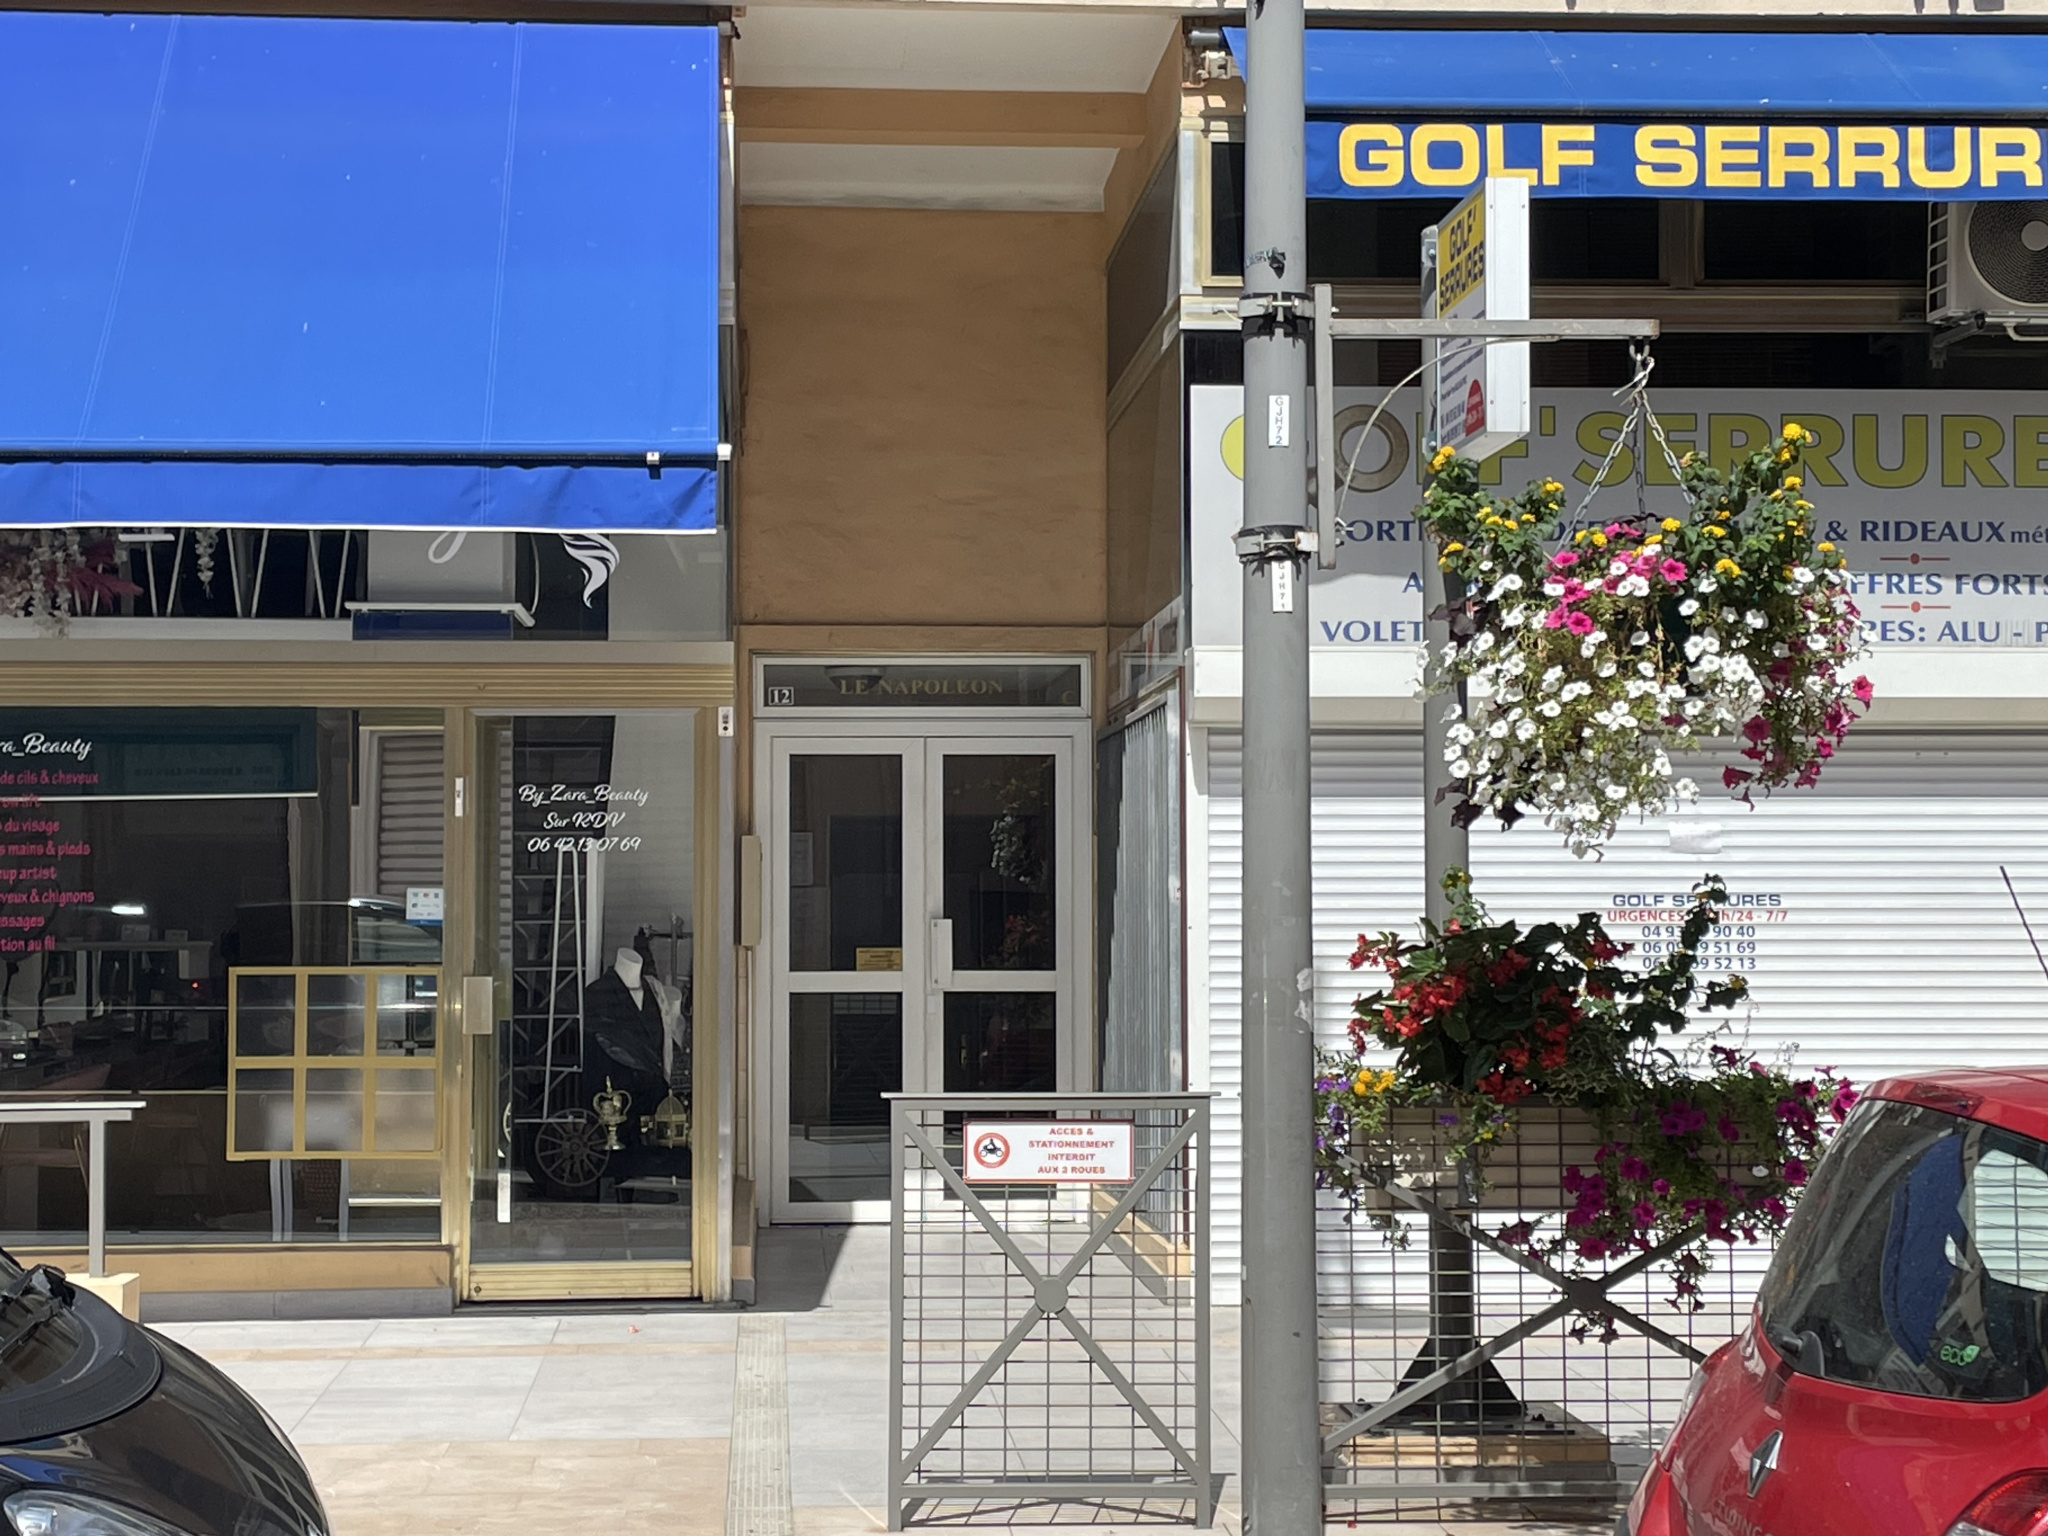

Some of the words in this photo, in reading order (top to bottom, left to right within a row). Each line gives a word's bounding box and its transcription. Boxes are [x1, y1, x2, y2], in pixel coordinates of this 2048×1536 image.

[1338, 123, 1595, 187] GOLF
[1440, 241, 1484, 313] SERRURES
[1274, 396, 1284, 446] GJH72
[1824, 520, 1848, 542] &
[1860, 520, 2005, 543] RIDEAUX
[1937, 620, 2000, 642] ALU
[771, 689, 791, 705] 12
[839, 679, 869, 695] LE
[878, 678, 1003, 695] NAPOLEON
[52, 769, 99, 785] cheveux
[4, 818, 20, 833] du
[22, 819, 61, 836] visage
[543, 811, 571, 829] Sur
[571, 811, 626, 828] RDV
[8, 842, 44, 856] mains
[58, 841, 91, 861] pieds
[527, 837, 551, 852] 06
[595, 837, 620, 852] 07
[19, 866, 57, 880] artist
[42, 888, 95, 908] chignons
[1613, 894, 1664, 907] GOLF
[1607, 910, 1685, 922] URGENCES
[1766, 910, 1788, 922] 7/7
[1642, 925, 1661, 938] 04
[1713, 925, 1732, 938] 90
[1736, 925, 1755, 938] 40
[27, 939, 43, 952] au
[44, 934, 56, 951] fil
[1642, 941, 1661, 954] 06
[1714, 941, 1731, 954] 51
[1737, 941, 1756, 954] 69
[1714, 956, 1733, 970] 52
[1738, 956, 1756, 970] 13
[1049, 1127, 1083, 1136] ACCES
[1087, 1127, 1094, 1136] &
[1028, 1140, 1115, 1149] STATIONNEMENT
[1048, 1153, 1096, 1162] INTERDIT
[1037, 1166, 1059, 1174] AUX
[1071, 1166, 1106, 1174] ROUES
